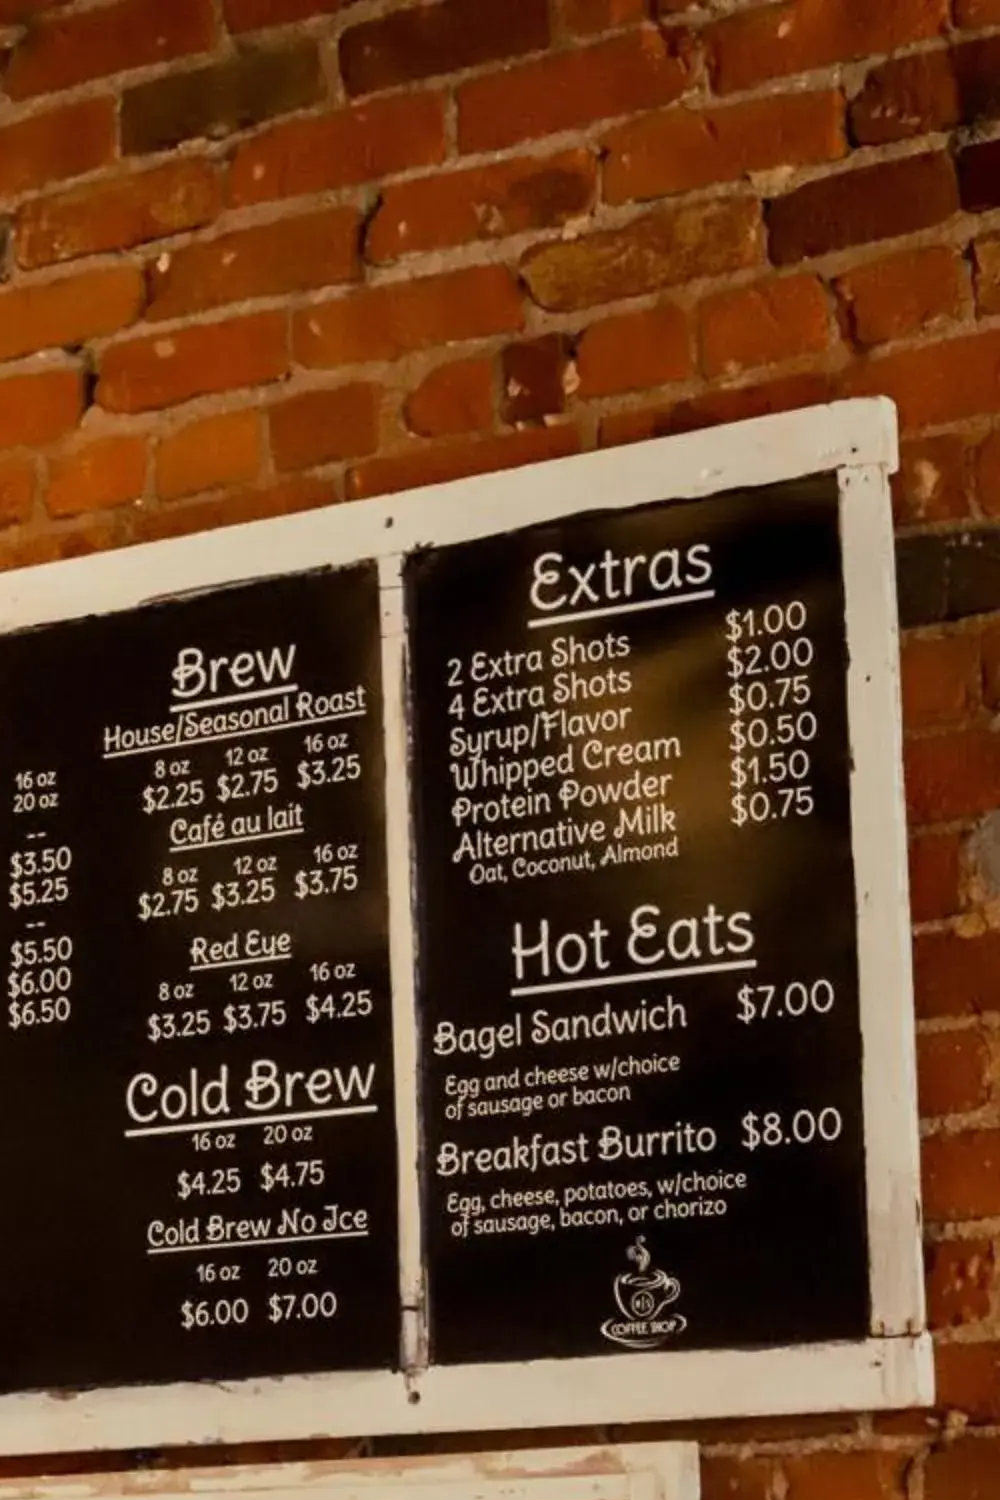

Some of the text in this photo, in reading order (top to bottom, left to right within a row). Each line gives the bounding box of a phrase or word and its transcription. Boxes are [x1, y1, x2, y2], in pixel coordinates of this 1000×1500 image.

[529, 543, 715, 616] Extras
[171, 644, 296, 698] Brew
[447, 633, 631, 687] 2 Extra Shots
[102, 684, 367, 756] House/Seasonal Roast
[450, 708, 632, 766] Syrup/Flavor
[449, 737, 681, 793] Whipped Cream
[729, 749, 810, 792] $1.50
[12, 791, 59, 813] 20 oz
[142, 779, 205, 815] $2.25
[451, 769, 673, 827] Protein Powder
[169, 802, 304, 851] Café au lait
[453, 801, 677, 862] Alternative Milk
[9, 846, 72, 880] $3.50
[468, 834, 679, 885] Oat, Coconut, Almond
[211, 876, 276, 912] $3.25
[10, 935, 73, 970] $5.50
[189, 929, 292, 964] Red Eye
[511, 903, 754, 980] Hot Eats
[7, 966, 72, 1000] $6.00
[8, 996, 71, 1030] $6.50
[223, 999, 287, 1034] $3.75
[433, 994, 688, 1060] Bagel Sandwich
[126, 1059, 376, 1123] Cold Brew
[444, 1053, 681, 1104] Egg and cheese w/choice
[444, 1085, 631, 1121] of sausage bacon
[436, 1121, 717, 1177] Breakfast Burrito
[741, 1106, 842, 1152] $8.00
[260, 1159, 325, 1193] $4.75
[563, 1169, 747, 1208] potatoes, w/choice
[147, 1217, 200, 1247] Cold
[205, 1214, 272, 1242] Brew
[276, 1207, 317, 1236] No
[559, 1198, 727, 1228] bacon, chorizo
[268, 1291, 337, 1324] $7.00
